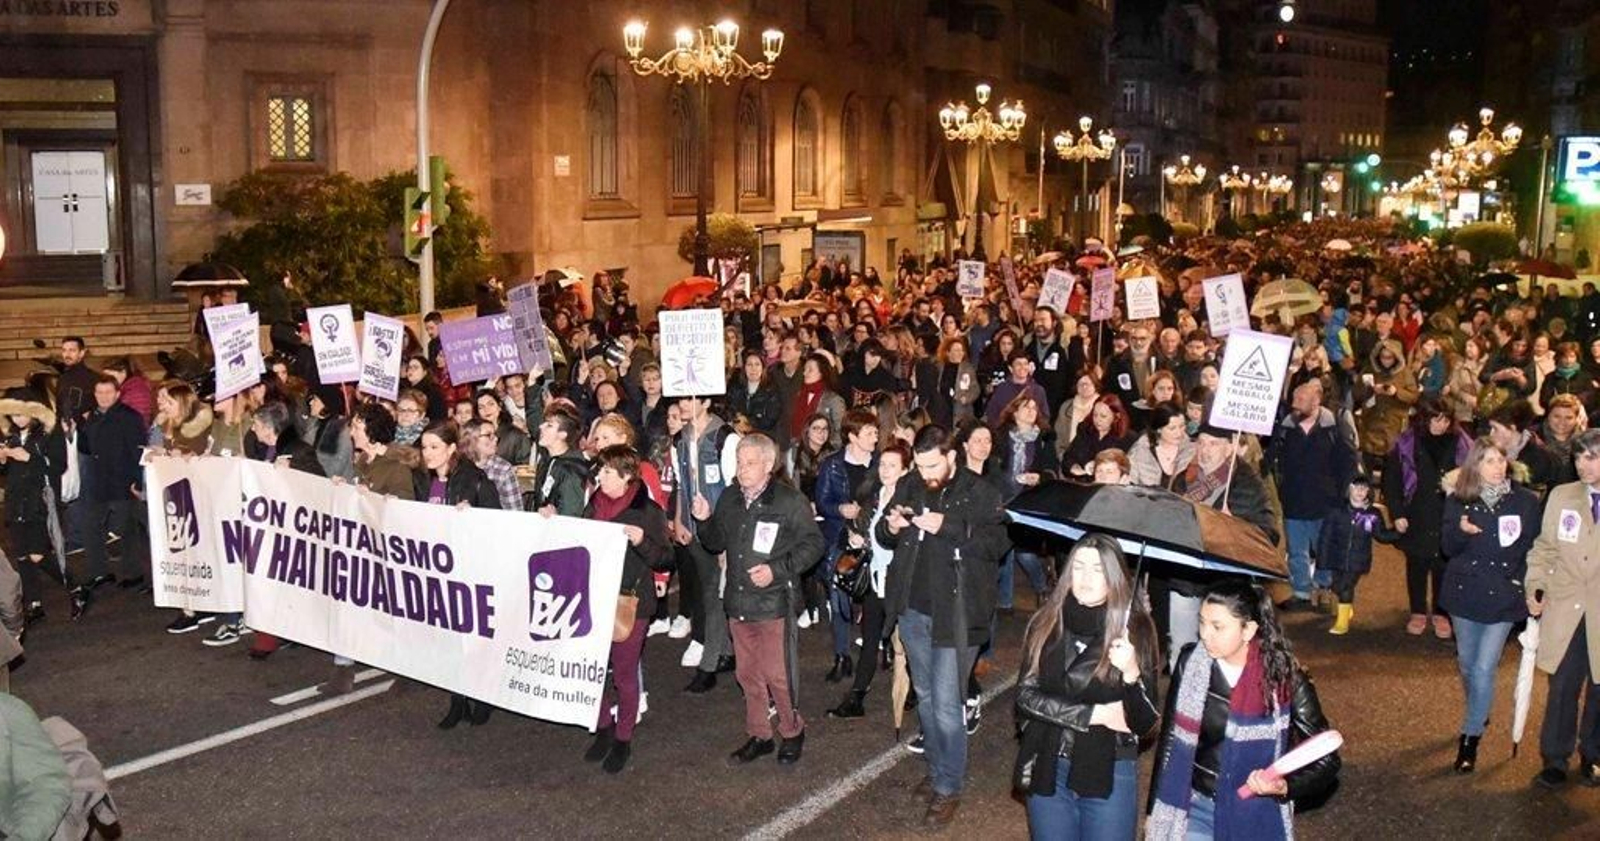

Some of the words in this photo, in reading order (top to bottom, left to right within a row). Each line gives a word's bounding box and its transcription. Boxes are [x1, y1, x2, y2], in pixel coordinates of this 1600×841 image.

[57, 0, 119, 16] ARTES
[1565, 143, 1600, 179] P
[1226, 387, 1274, 401] TRABALLO
[1232, 379, 1271, 393] MESMO
[1228, 401, 1266, 413] MESMO
[294, 506, 454, 574] CAPITALISMO
[188, 563, 213, 580] unida
[267, 533, 316, 590] HAI
[322, 547, 495, 639] IGUALDADE
[506, 647, 555, 677] esquerda
[560, 656, 605, 684] unida
[508, 676, 530, 694] área
[533, 683, 548, 698] da
[552, 690, 597, 707] muller
